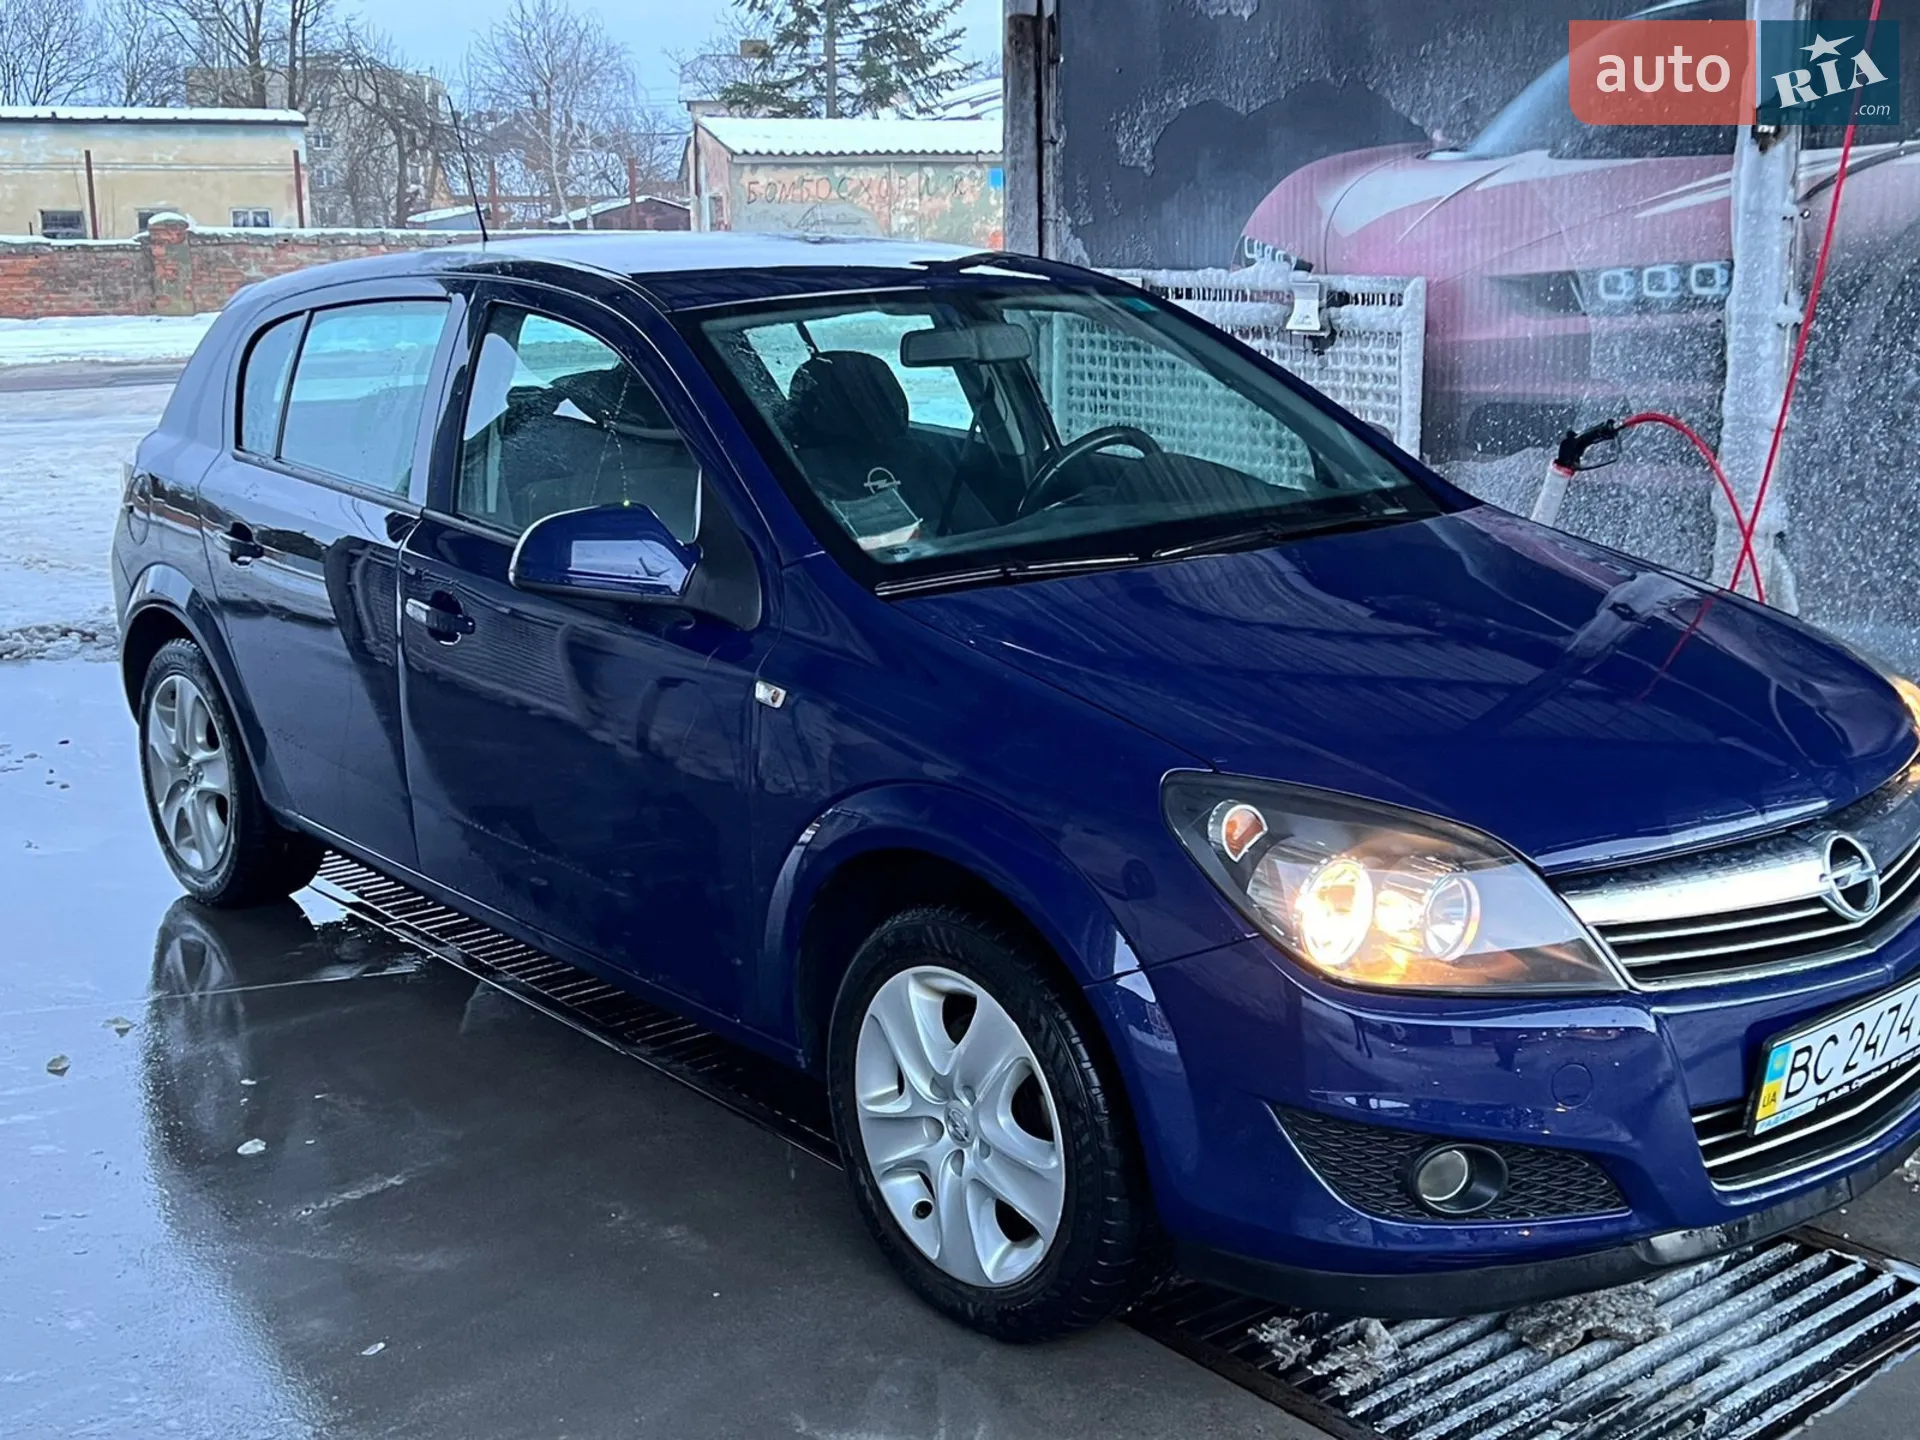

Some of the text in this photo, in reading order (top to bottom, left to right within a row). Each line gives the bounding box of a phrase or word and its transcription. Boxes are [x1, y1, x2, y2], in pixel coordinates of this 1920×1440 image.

[1784, 1034, 1839, 1100] BC
[1842, 993, 1920, 1075] 2474
[1762, 1091, 1777, 1108] UA
